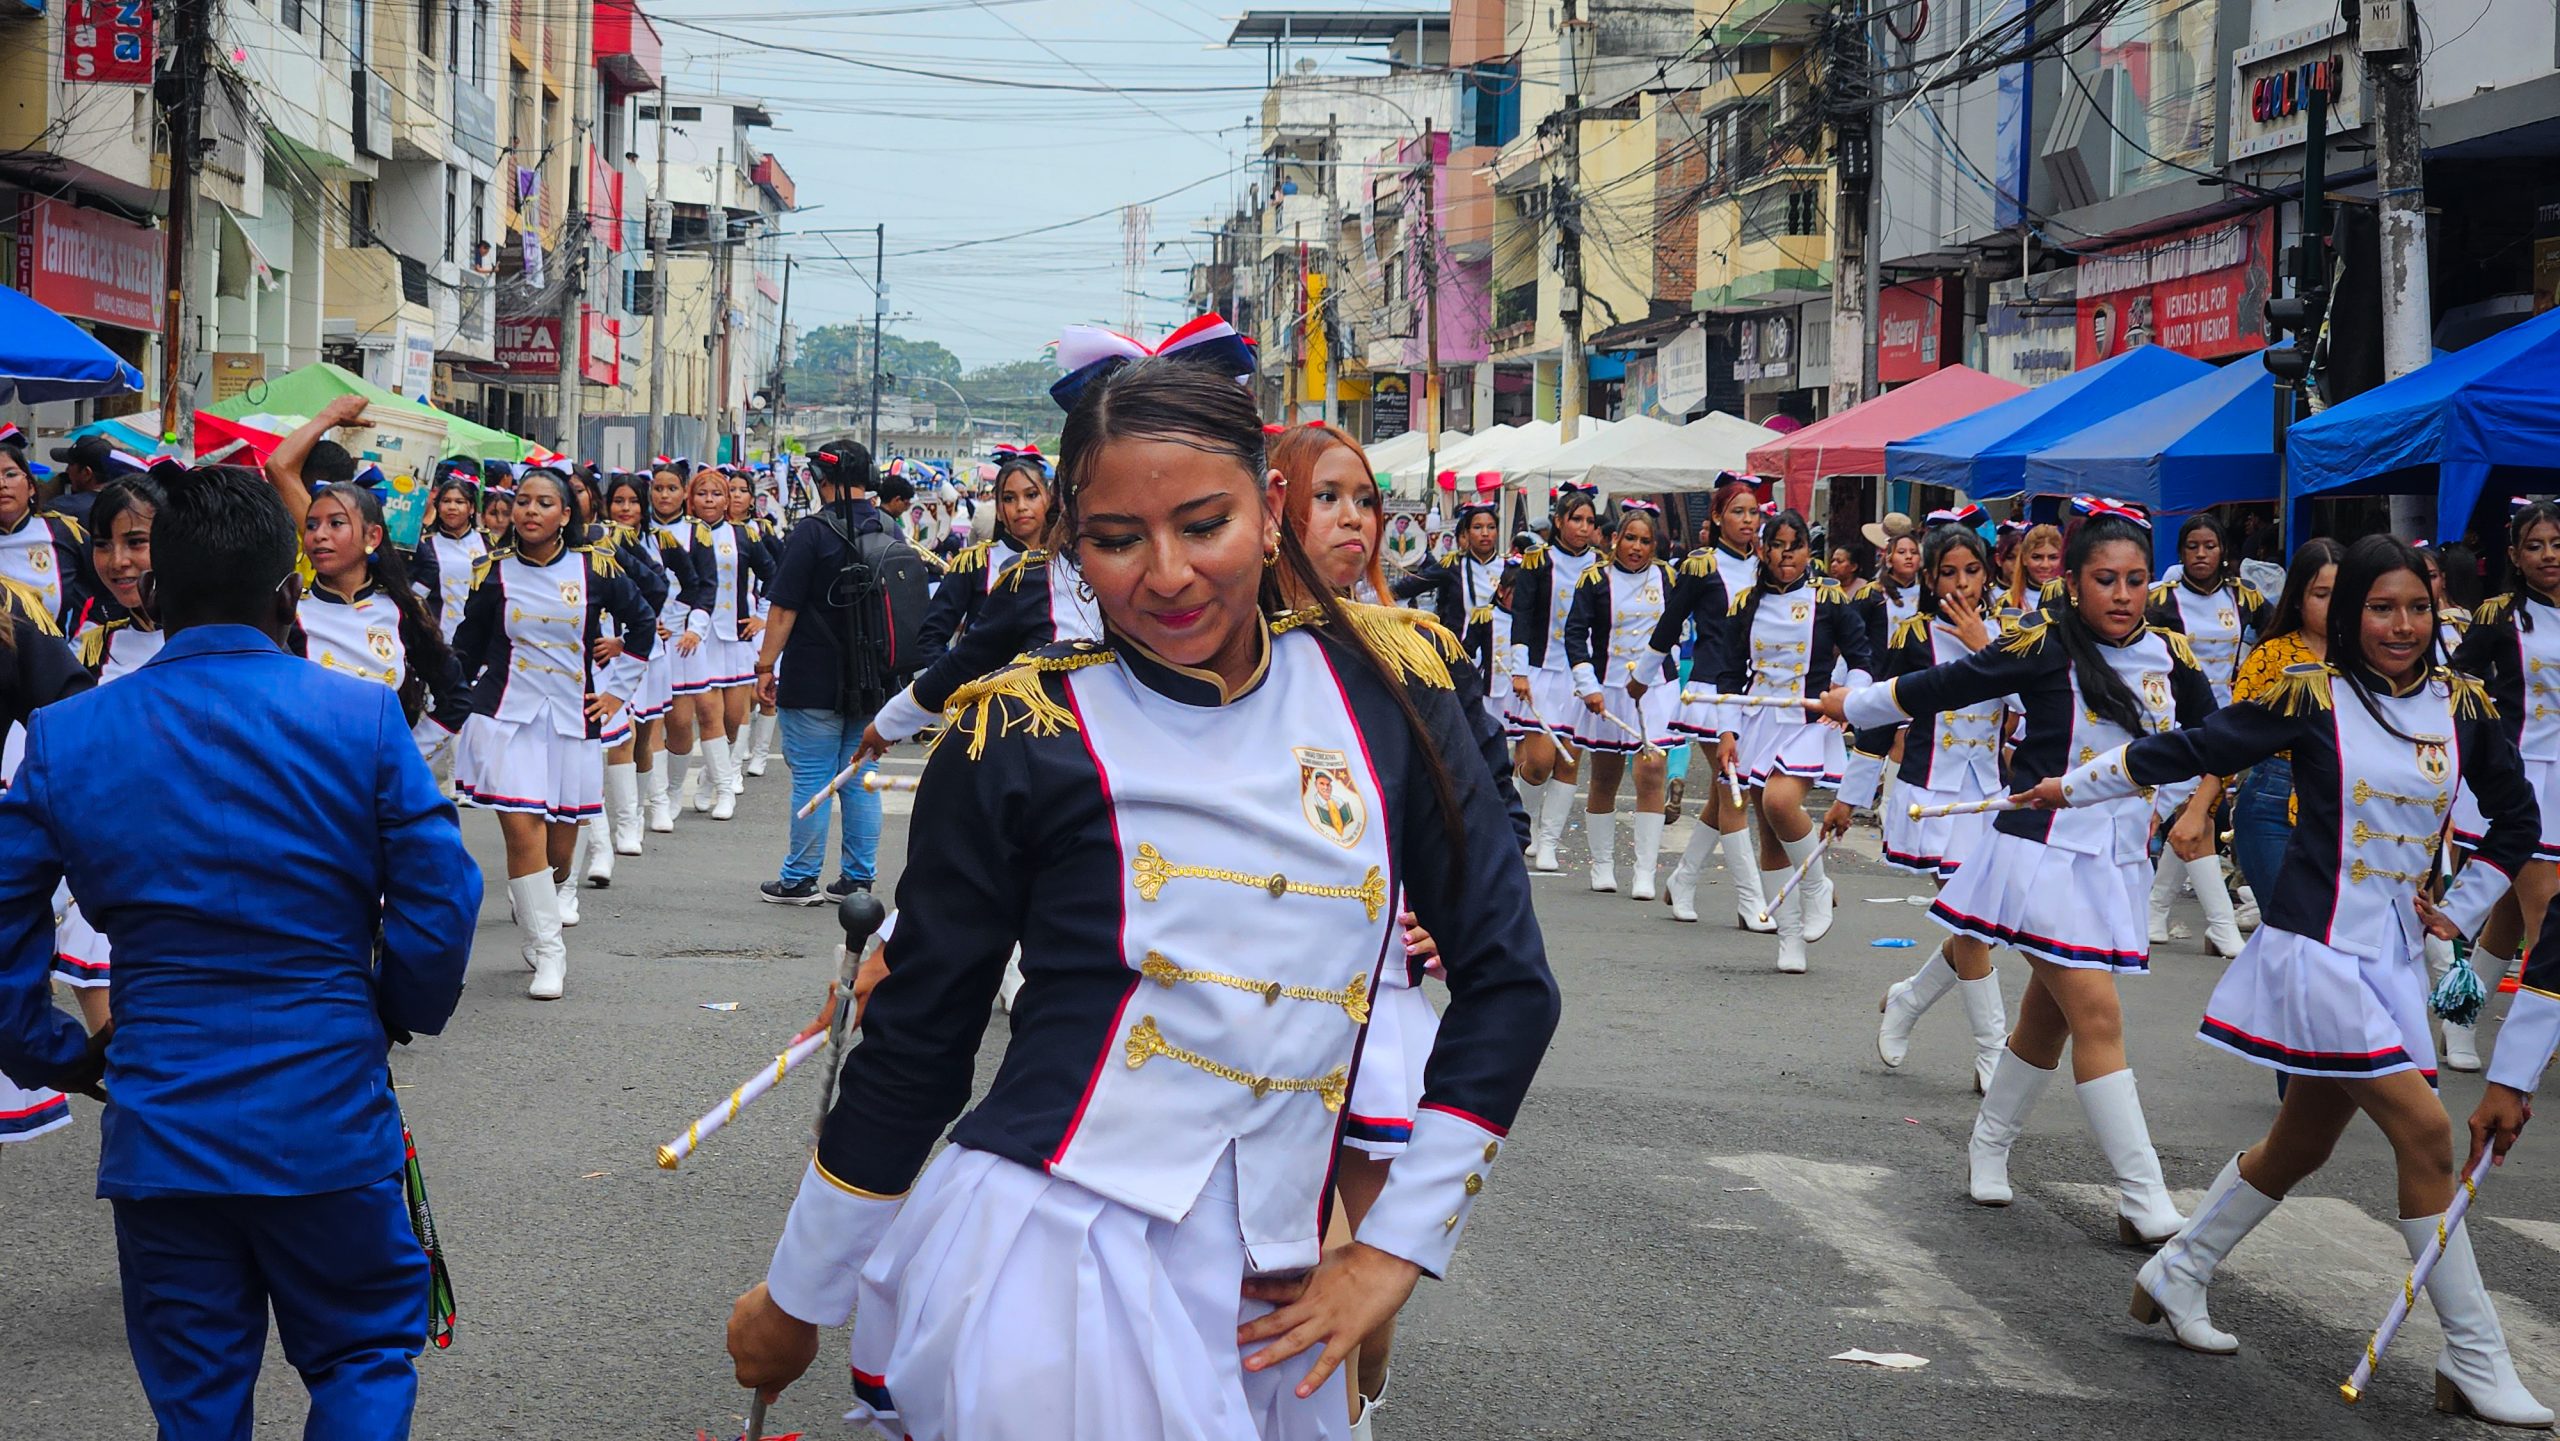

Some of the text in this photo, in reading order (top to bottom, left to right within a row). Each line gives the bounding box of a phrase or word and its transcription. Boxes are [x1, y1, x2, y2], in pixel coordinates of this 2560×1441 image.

[2372, 4, 2390, 21] N11
[42, 203, 150, 296] farmacias suiza
[2150, 239, 2187, 283] MOTO
[2166, 286, 2228, 319] VENTAS AL POR
[1882, 311, 1920, 353] Shineray
[2163, 315, 2230, 348] MAYOR Y MENOR
[499, 351, 555, 363] ORIENTE
[417, 1200, 434, 1250] Kawasaki
